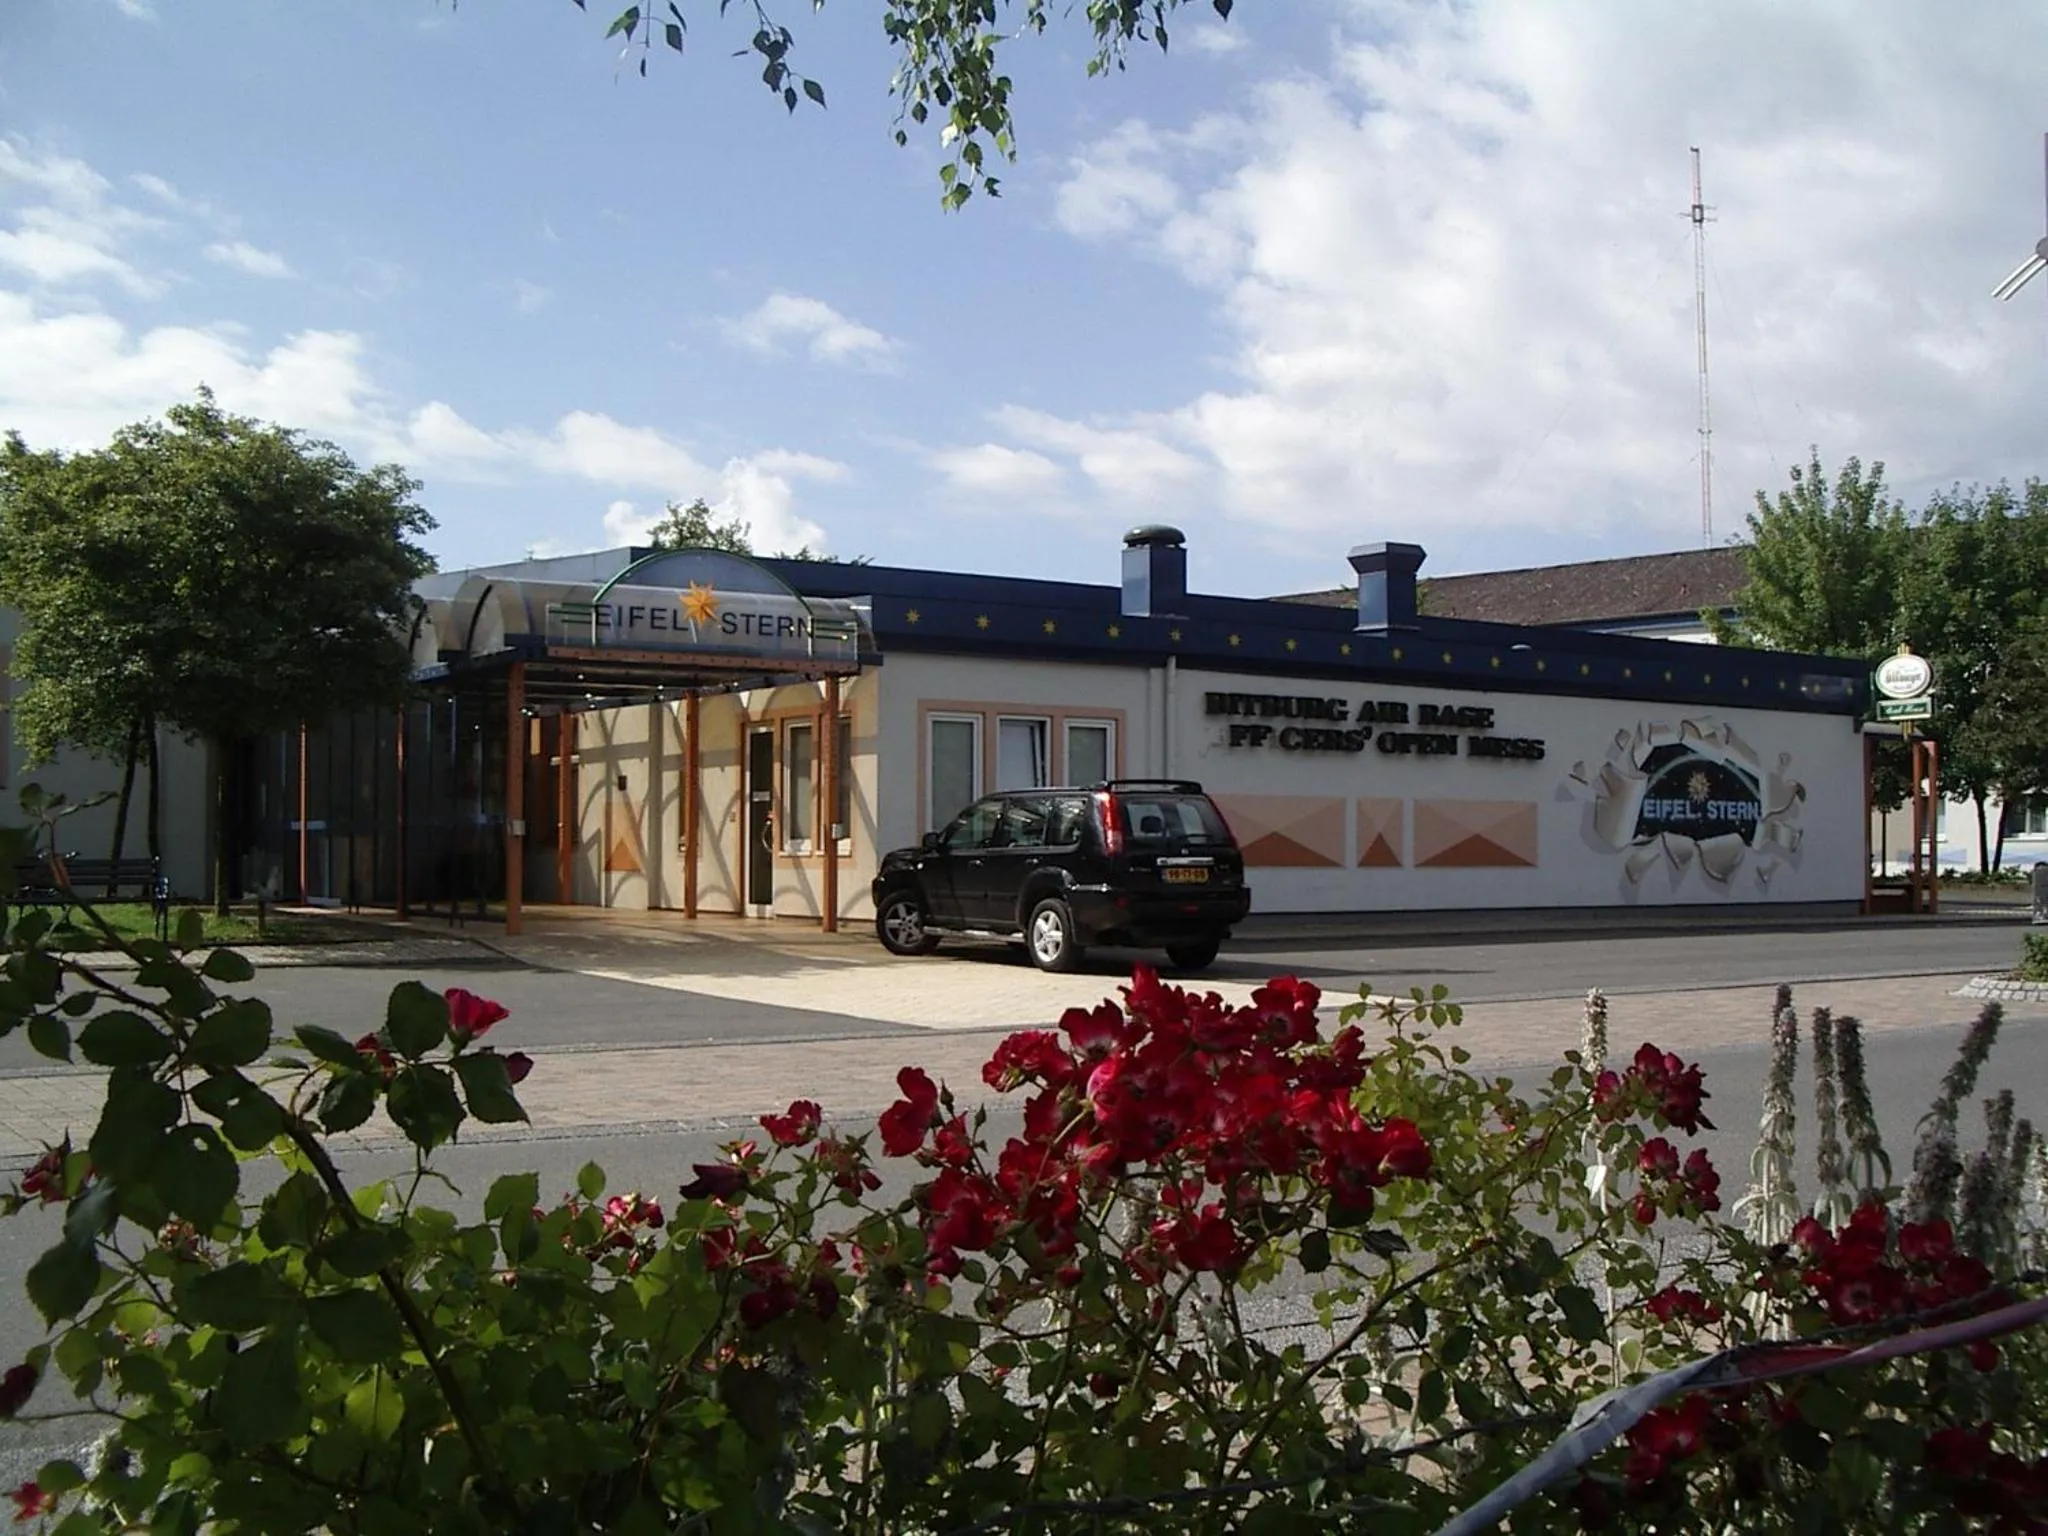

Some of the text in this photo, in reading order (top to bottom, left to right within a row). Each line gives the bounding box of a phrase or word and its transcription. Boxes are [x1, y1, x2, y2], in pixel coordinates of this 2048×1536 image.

[595, 603, 813, 638] EIFEL STERN
[1205, 692, 1494, 728] BITBURG AIR BASE
[1377, 731, 1458, 755] OPEN
[1468, 736, 1545, 760] MESS
[1643, 799, 1760, 820] EIFEL STERN
